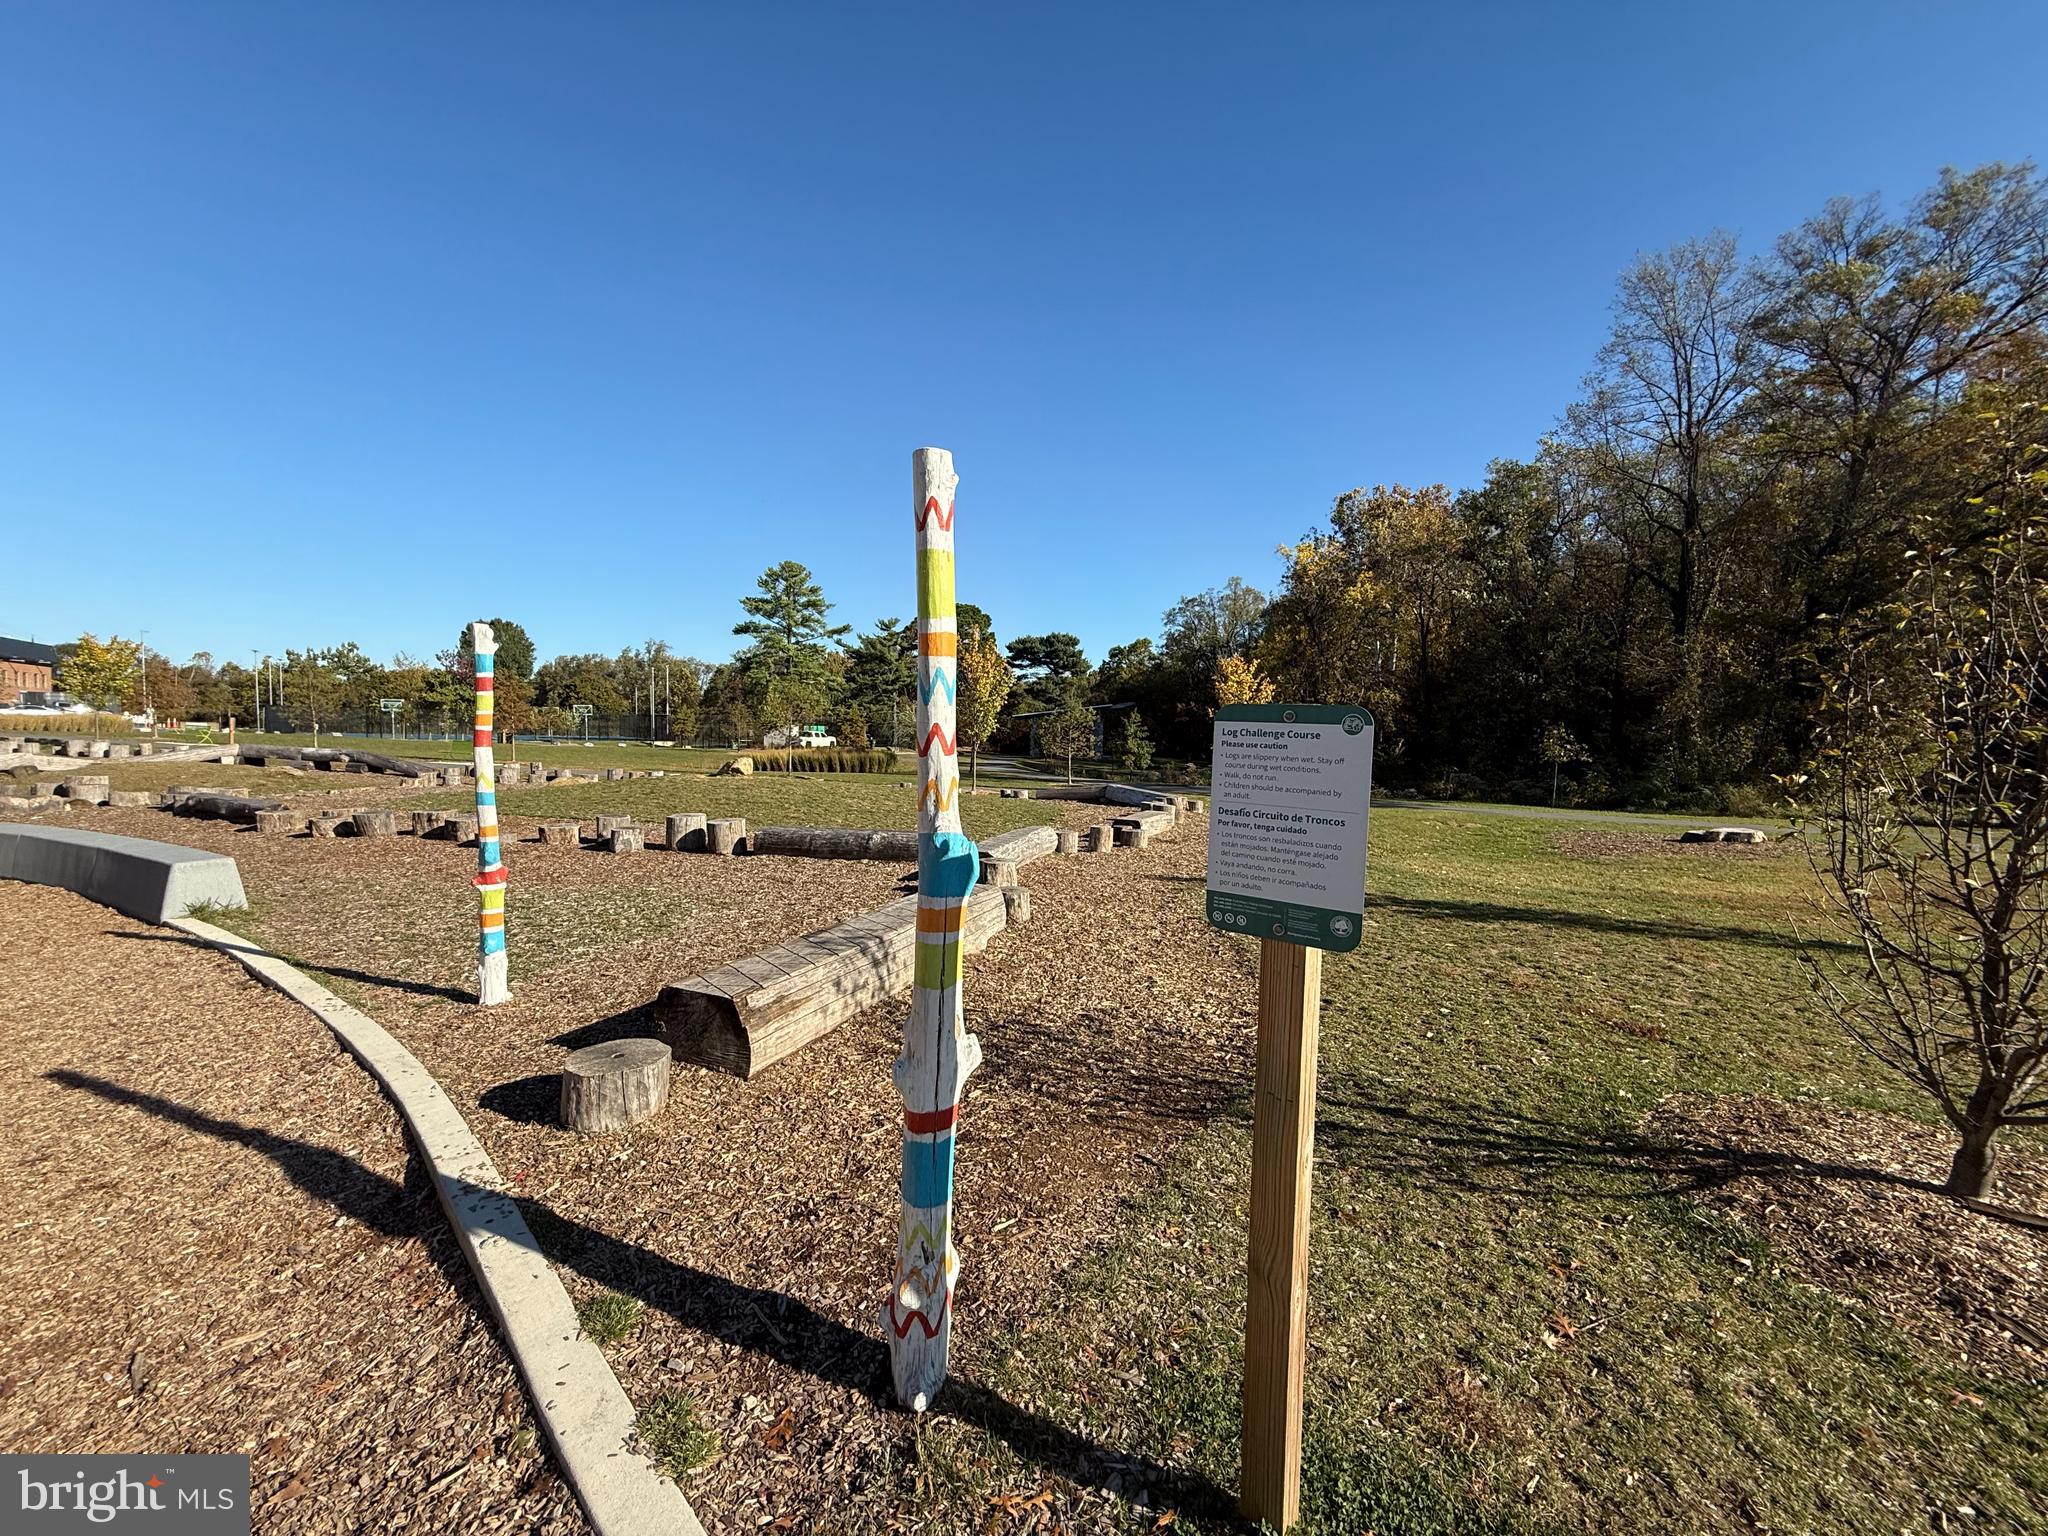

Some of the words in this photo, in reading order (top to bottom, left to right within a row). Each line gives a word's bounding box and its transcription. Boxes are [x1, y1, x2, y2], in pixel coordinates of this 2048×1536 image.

[1222, 728, 1238, 738] Log
[1240, 729, 1285, 740] Challenge
[1287, 730, 1320, 740] Course
[1222, 740, 1244, 748] Please
[1253, 754, 1279, 762] slippery
[1318, 757, 1332, 765] Stay
[1247, 763, 1268, 771] during
[1283, 766, 1321, 774] conditions.
[1285, 788, 1332, 797] accompanied
[1218, 807, 1250, 818] Desafío
[1253, 810, 1289, 821] Circuito
[1292, 813, 1303, 822] de
[1305, 814, 1346, 827] Troncos
[1231, 820, 1252, 830] favor,
[1254, 823, 1275, 832] tenga
[1276, 824, 1308, 835] cuidado
[1234, 832, 1257, 841] troncos
[1272, 836, 1314, 848] resbaladizos
[1315, 842, 1342, 850] cuando
[1240, 843, 1268, 852] mojados.
[1312, 852, 1338, 861] alejado
[1232, 852, 1255, 860] camino
[1256, 855, 1281, 863] cuando
[1298, 860, 1326, 869] mojado.
[1236, 862, 1266, 872] andando,
[1232, 872, 1248, 880] niños
[1250, 874, 1270, 882] deben
[1278, 878, 1326, 891] acompañados
[1241, 882, 1263, 891] adulto.
